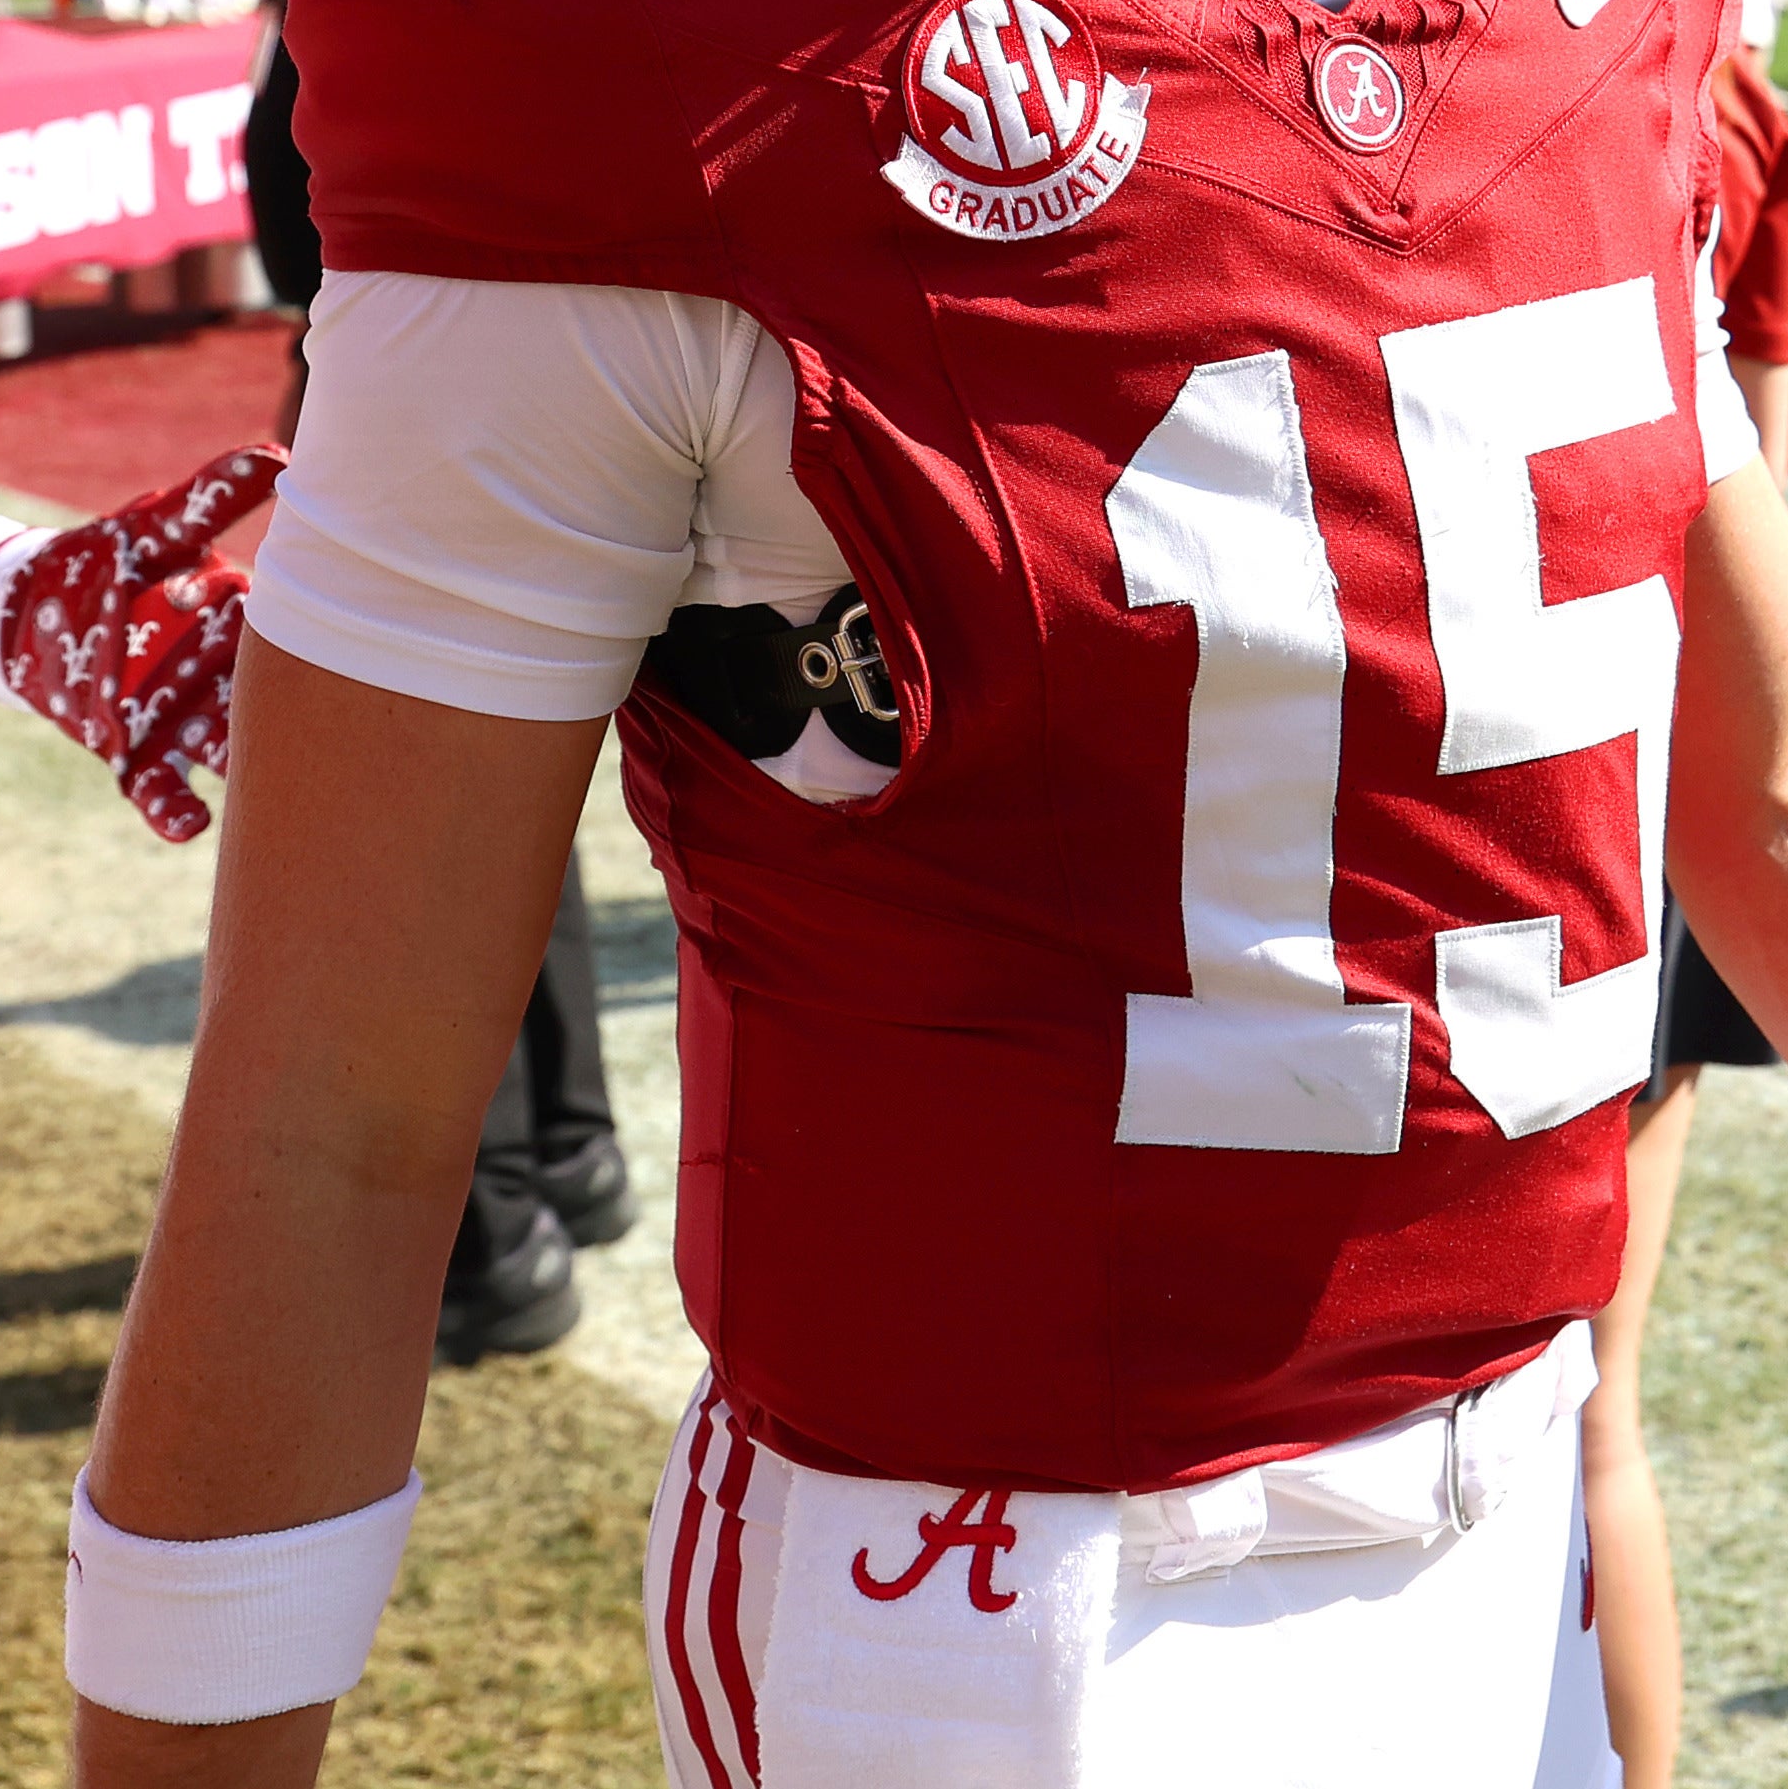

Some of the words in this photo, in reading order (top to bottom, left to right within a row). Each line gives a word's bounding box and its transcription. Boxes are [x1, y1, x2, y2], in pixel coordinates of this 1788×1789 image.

[1336, 58, 1389, 123] A
[929, 130, 1131, 233] GRADUATE
[1104, 274, 1682, 1155] 15
[850, 1486, 1018, 1612] A
